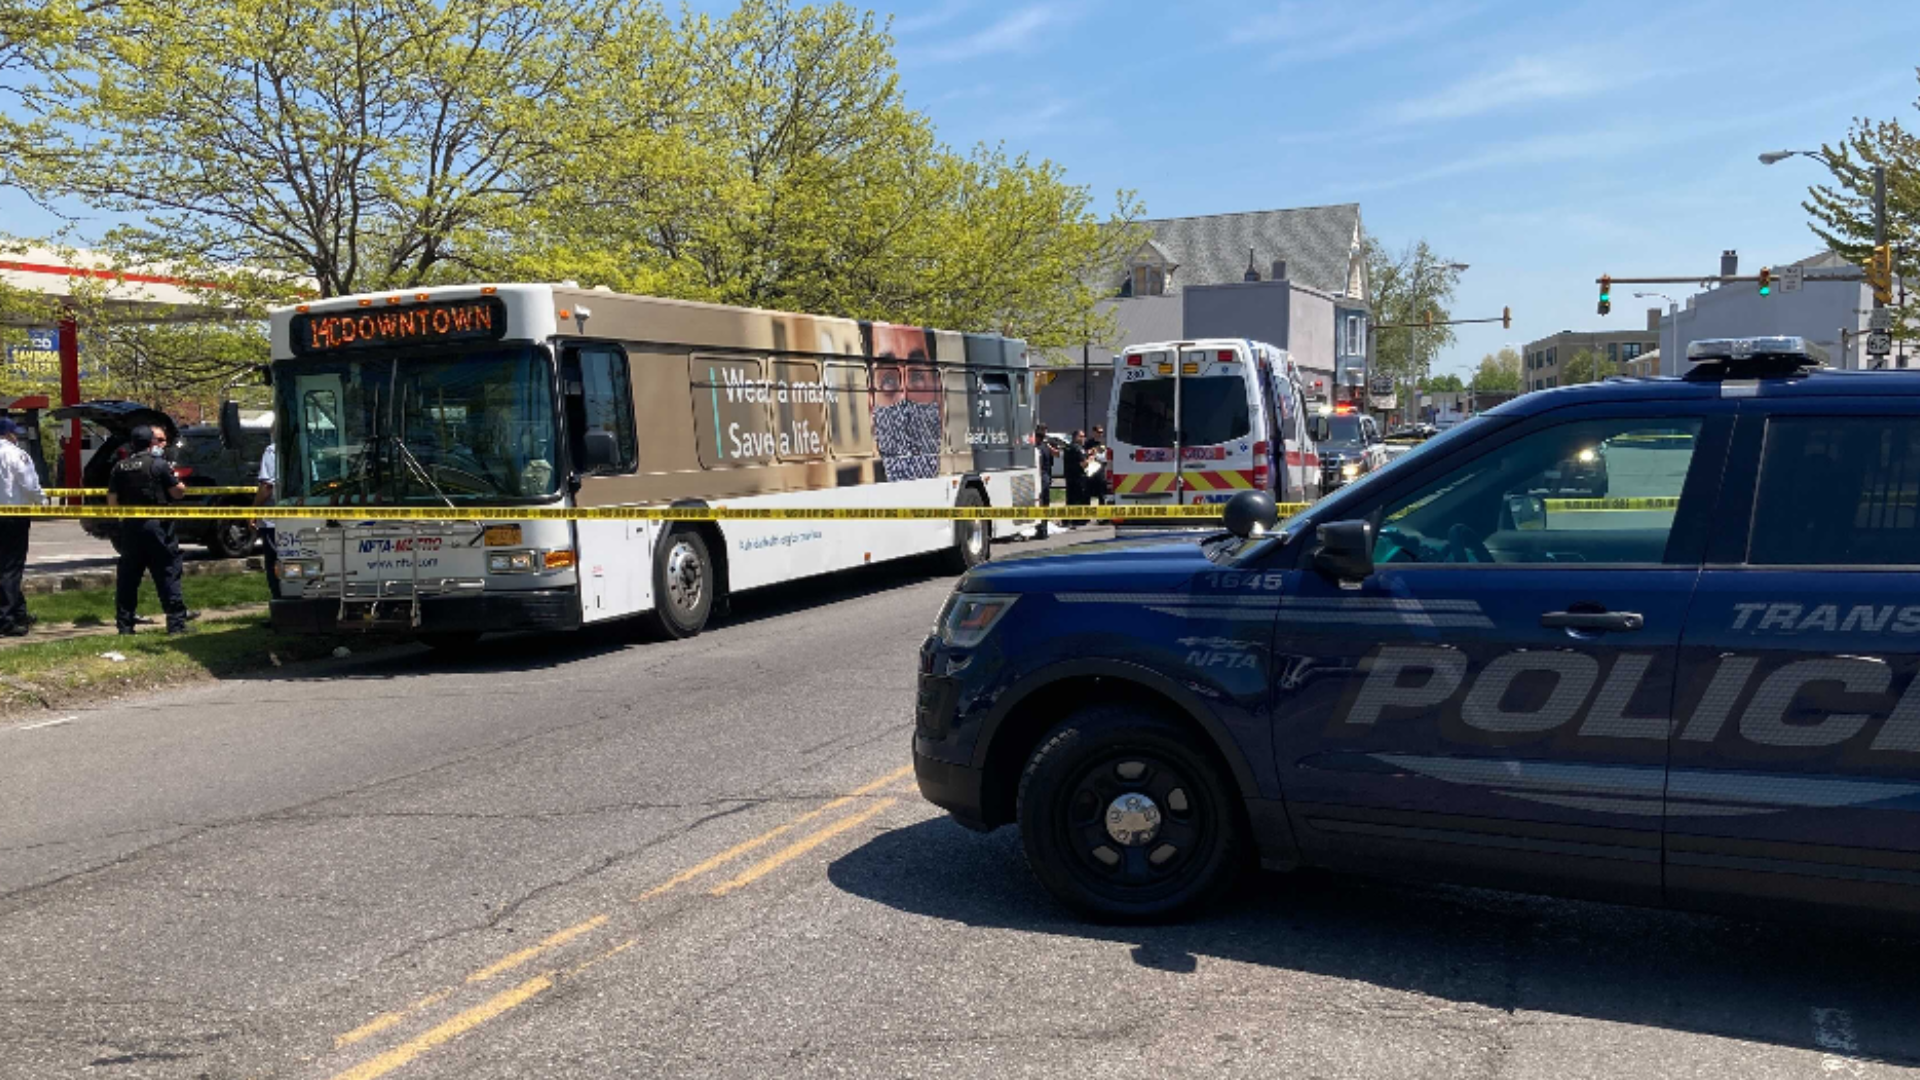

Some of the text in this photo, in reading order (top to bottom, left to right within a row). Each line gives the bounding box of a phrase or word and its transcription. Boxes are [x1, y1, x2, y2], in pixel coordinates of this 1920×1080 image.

[341, 305, 492, 342] DOWNTOWN
[722, 366, 839, 403] Wear a mask.
[728, 418, 825, 458] Save a life.
[1205, 572, 1282, 590] 1645
[1185, 650, 1258, 668] NFTA
